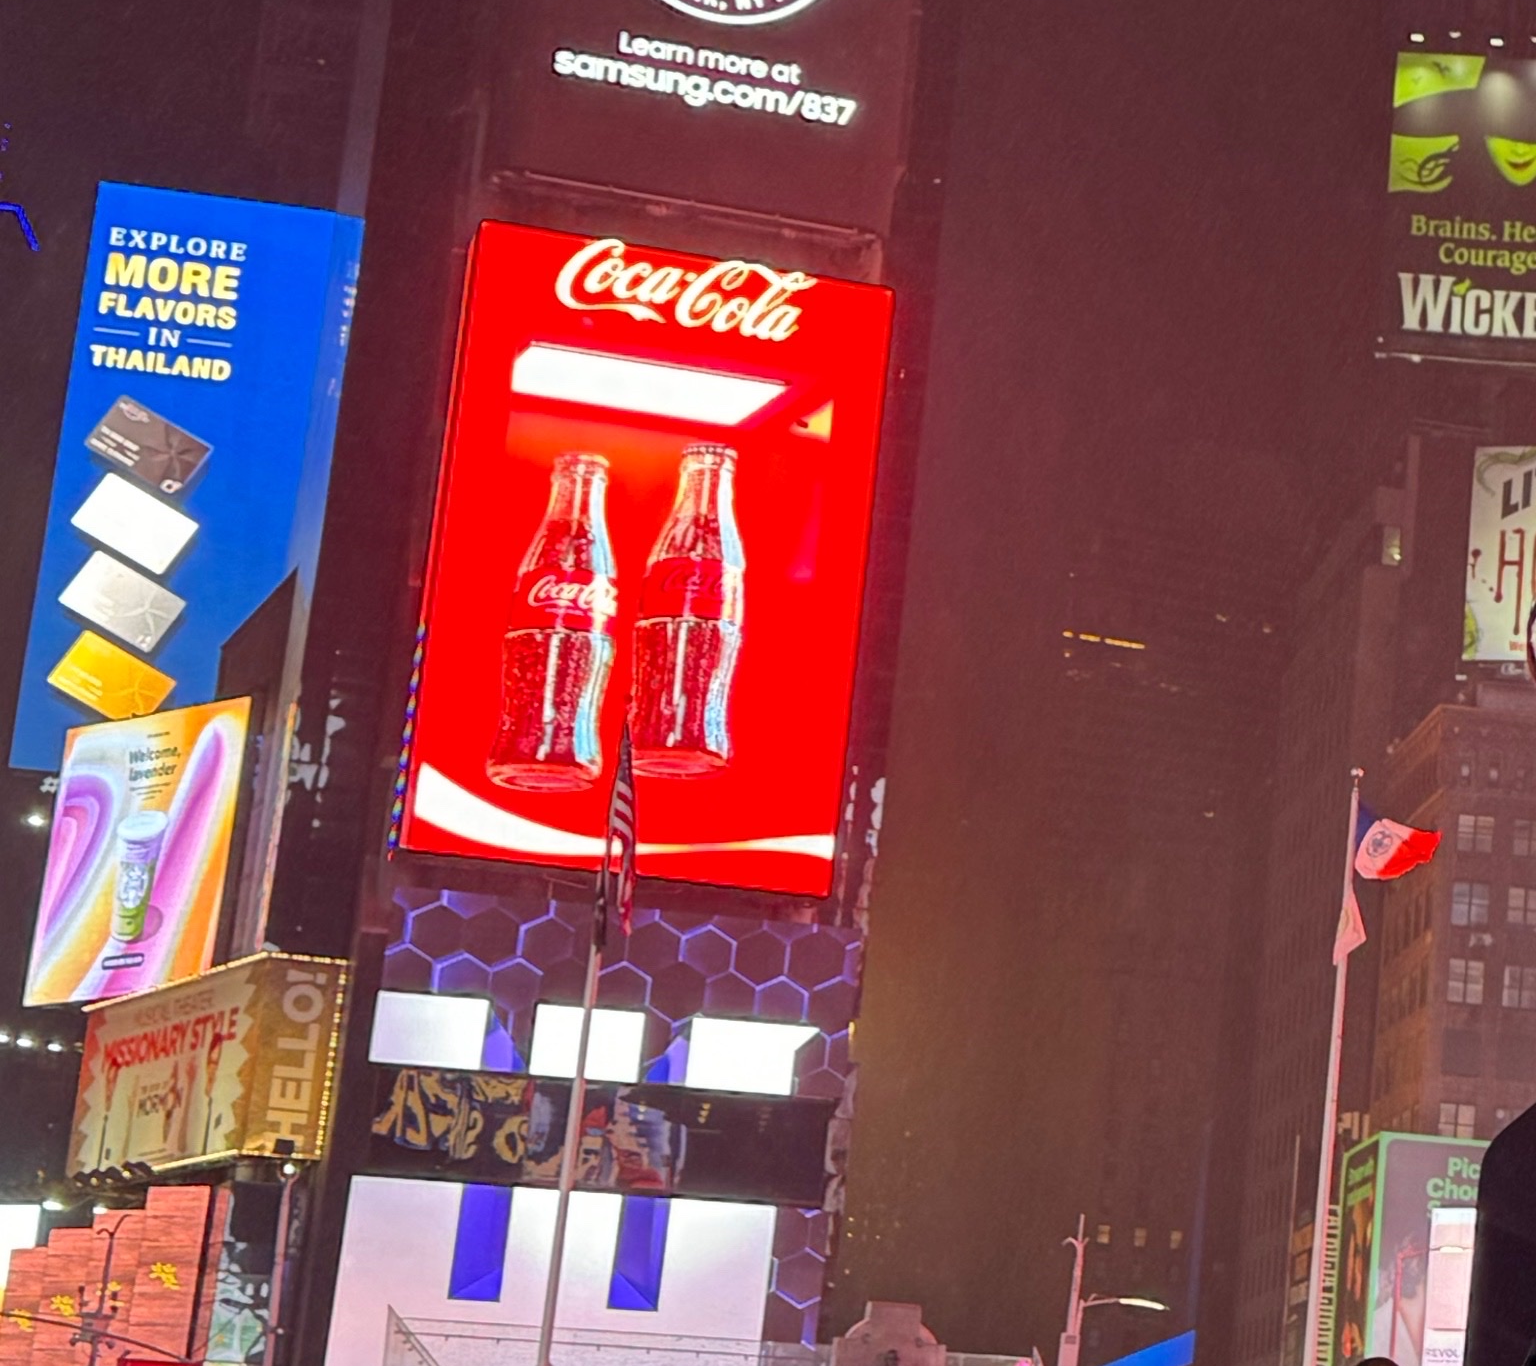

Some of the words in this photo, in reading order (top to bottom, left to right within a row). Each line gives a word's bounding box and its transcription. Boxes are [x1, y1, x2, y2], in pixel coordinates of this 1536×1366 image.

[618, 31, 694, 64] Learn
[698, 47, 768, 78] more
[771, 59, 802, 85] at
[553, 48, 858, 127] samsung.com/837
[108, 226, 248, 262] EXPLORE
[1410, 215, 1497, 241] Brains.
[104, 252, 242, 301] MORE
[98, 291, 237, 330] FLAVORS
[147, 326, 181, 348] IN
[90, 344, 232, 382] THAILAND
[129, 746, 181, 765] Welcome,
[129, 762, 178, 783] lavender
[264, 969, 328, 1146] HELLO!
